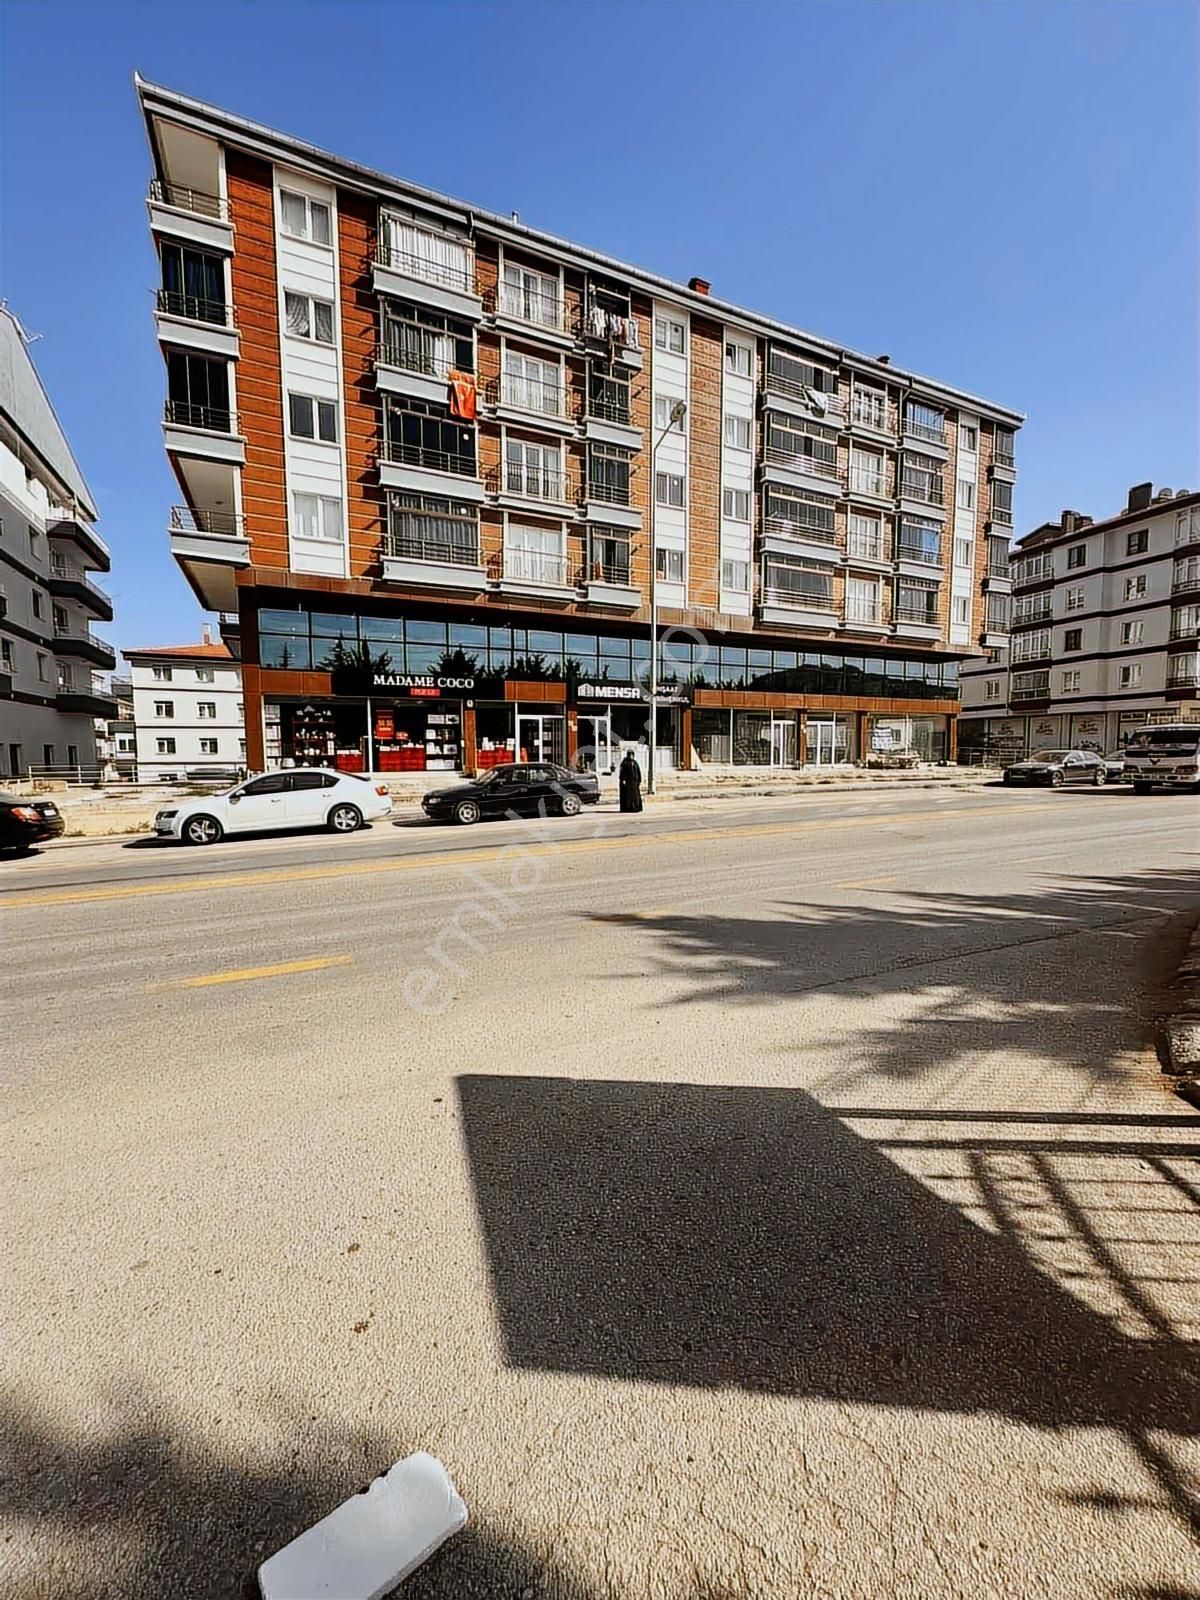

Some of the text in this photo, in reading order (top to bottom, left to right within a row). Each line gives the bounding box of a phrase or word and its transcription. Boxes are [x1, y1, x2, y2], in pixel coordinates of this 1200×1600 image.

[373, 674, 475, 689] MADAME COCO
[595, 685, 640, 699] MENSA
